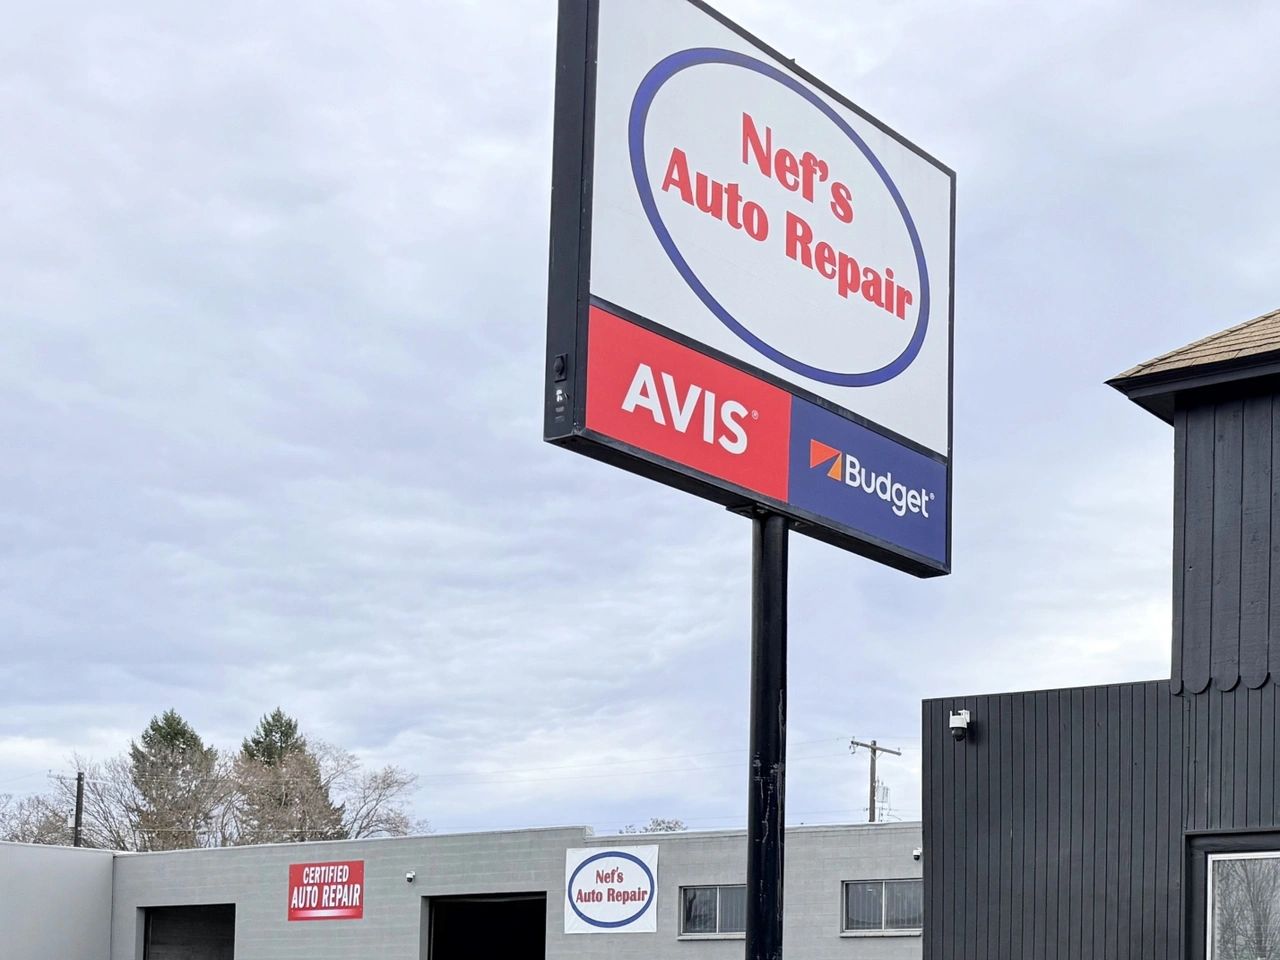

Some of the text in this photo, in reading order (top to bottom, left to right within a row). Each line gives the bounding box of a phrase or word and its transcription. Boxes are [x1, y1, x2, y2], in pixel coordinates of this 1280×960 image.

[742, 111, 854, 224] Nef's
[661, 147, 913, 321] Auto Repair
[621, 363, 749, 455] AVIS
[845, 453, 930, 518] Budget
[290, 884, 361, 909] AUTO REPAIR
[303, 865, 349, 884] CERTIFIED
[576, 887, 648, 904] Auto Repair
[595, 866, 624, 884] Nef's
